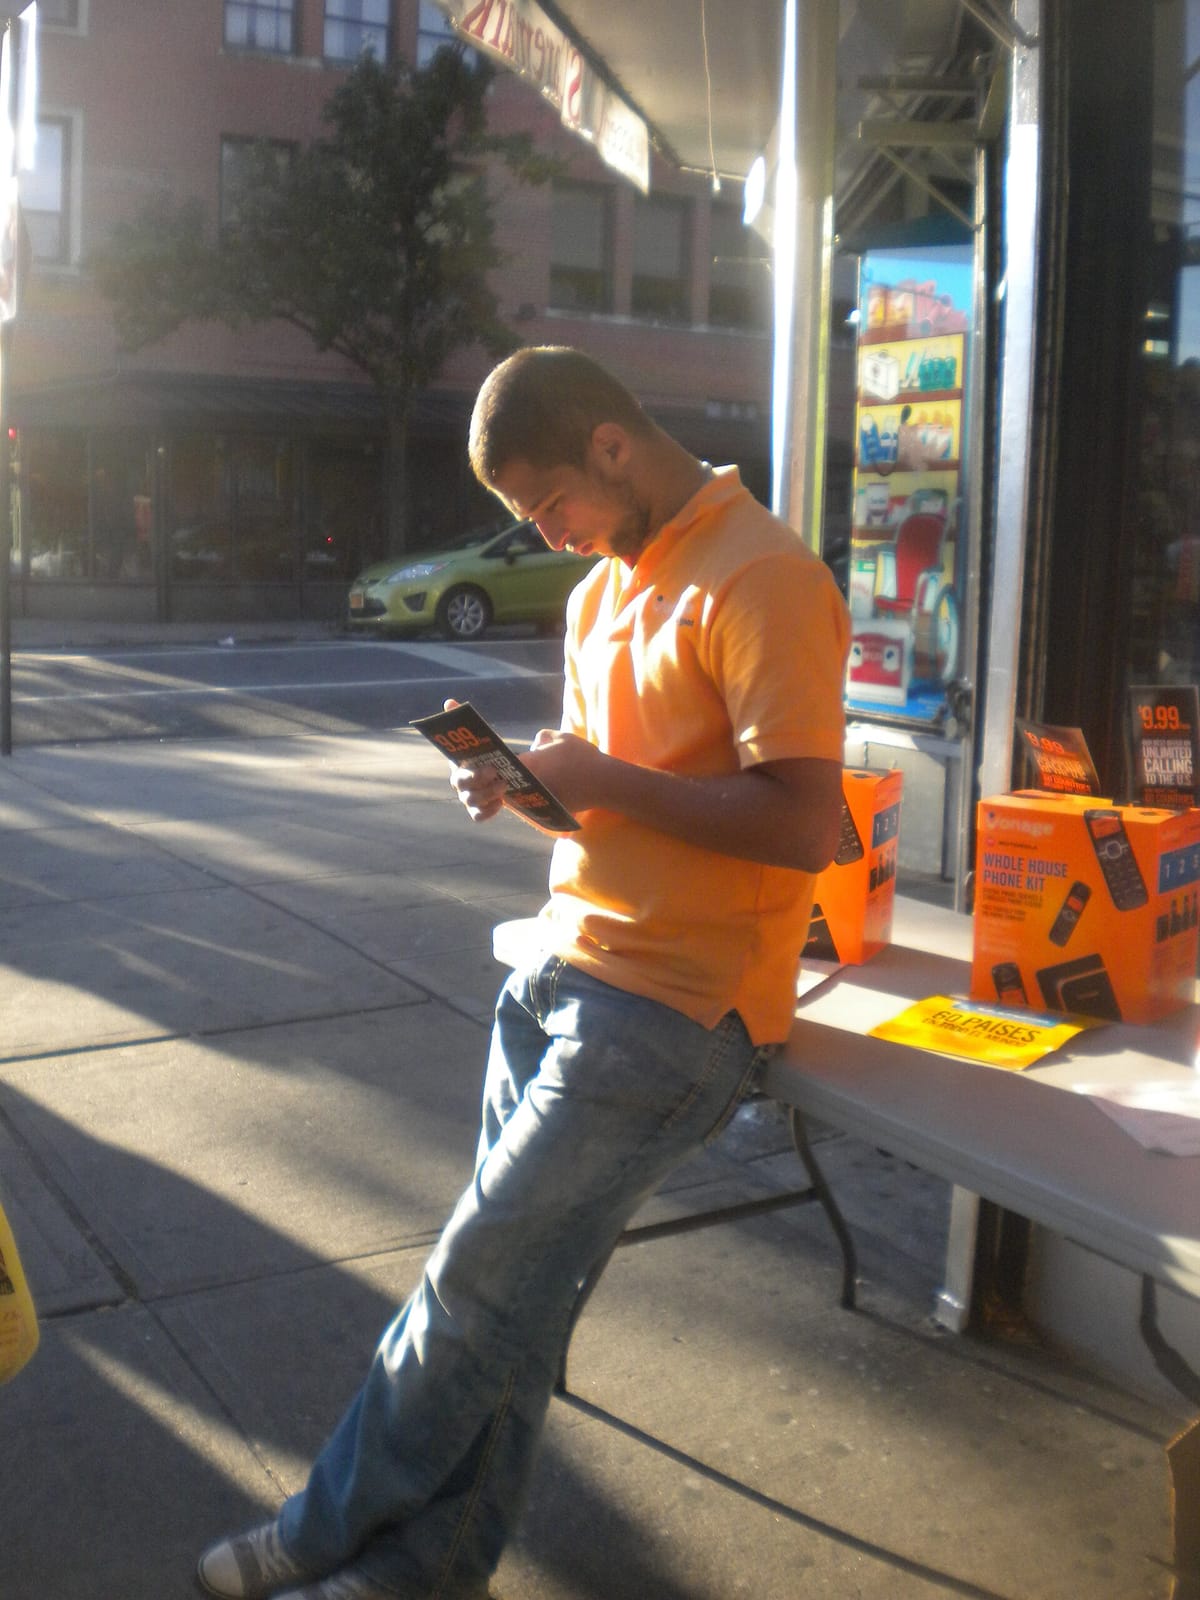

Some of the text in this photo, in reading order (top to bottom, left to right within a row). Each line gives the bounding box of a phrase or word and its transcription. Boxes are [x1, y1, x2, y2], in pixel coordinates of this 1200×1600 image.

[1142, 746, 1192, 759] UNLIMITED
[1144, 759, 1193, 774] CALLING
[1145, 774, 1157, 785] TO
[1159, 774, 1175, 785] THE
[984, 853, 1068, 878] WHOLE HOUSE
[984, 869, 1045, 892] PHONE KIT
[932, 1010, 963, 1022] 60
